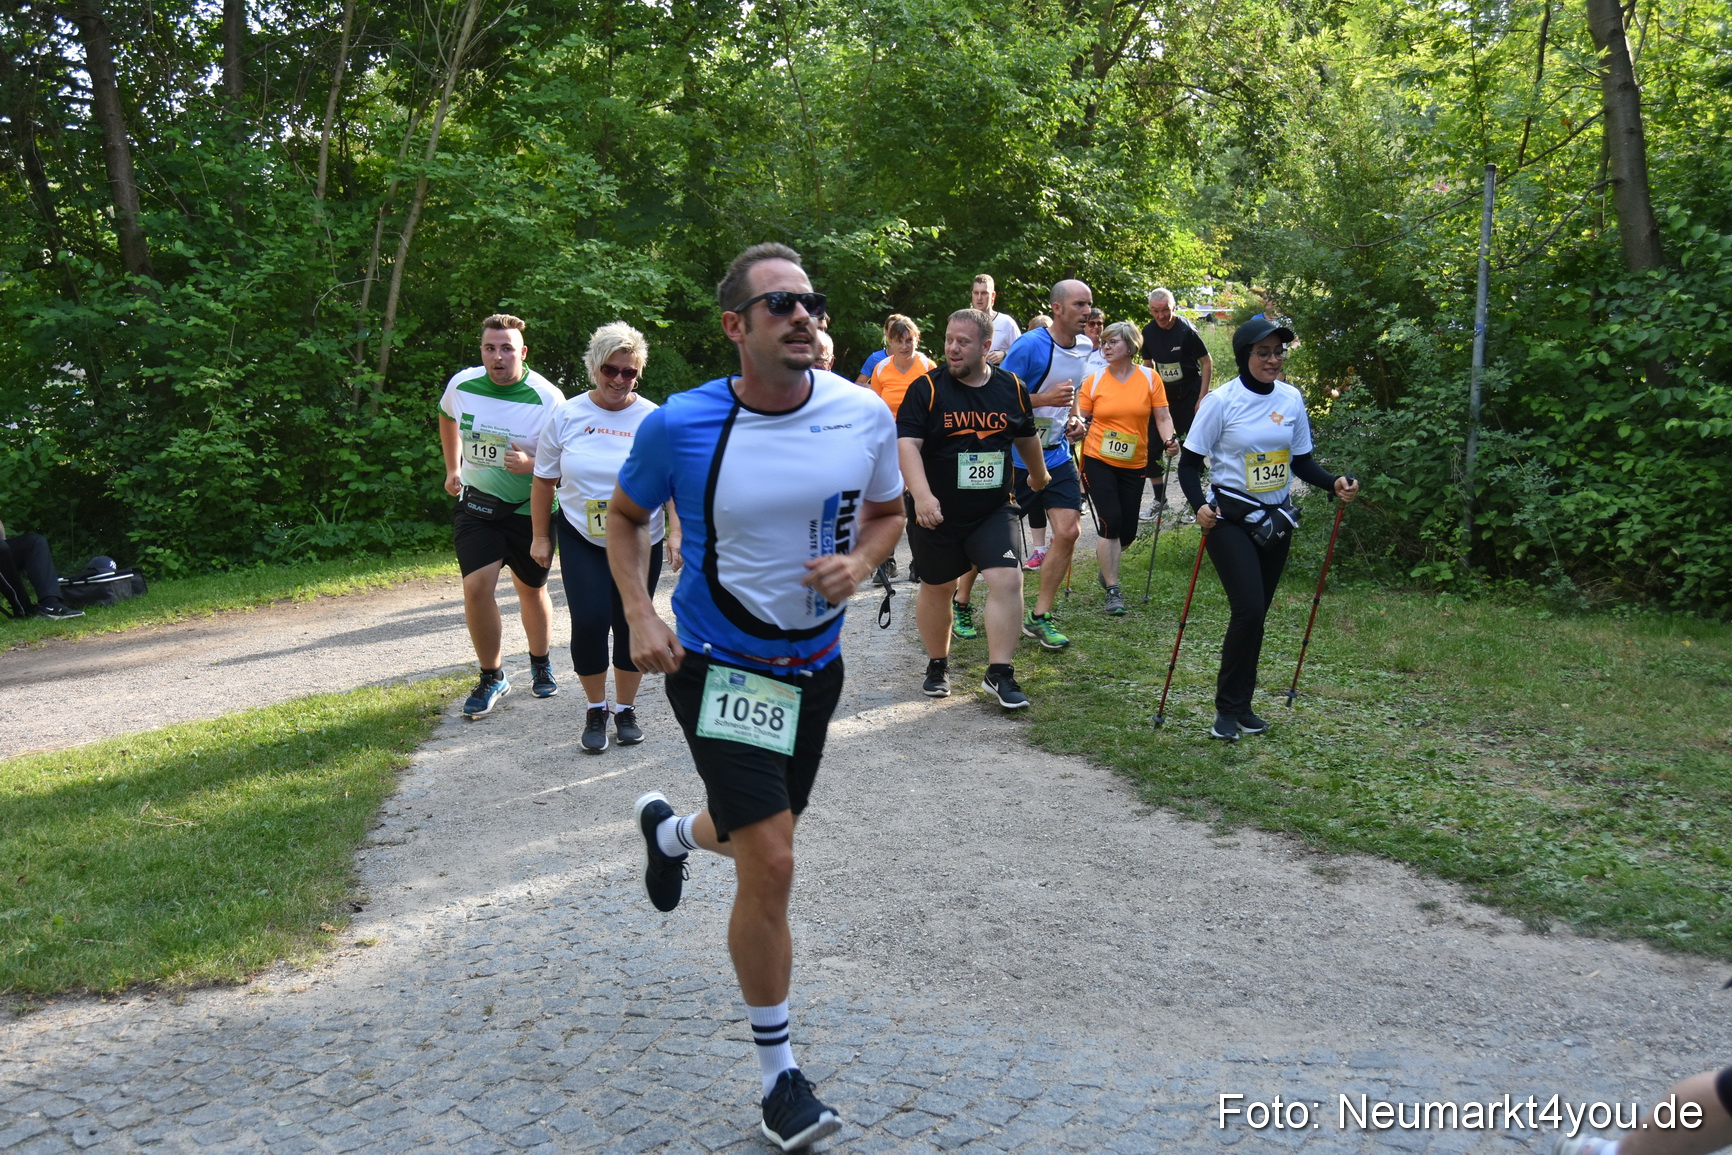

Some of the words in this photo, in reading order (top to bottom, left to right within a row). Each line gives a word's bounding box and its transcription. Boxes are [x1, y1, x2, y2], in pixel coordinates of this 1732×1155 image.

[944, 412, 954, 428] BIT
[952, 411, 1008, 429] WINGS
[472, 443, 497, 459] 119
[1108, 440, 1129, 453] 109
[968, 465, 995, 479] 288
[1253, 463, 1285, 481] 1342
[808, 518, 818, 551] WASTE
[716, 693, 785, 731] 1058
[714, 718, 753, 731] Schneider
[753, 726, 781, 739] Thomas
